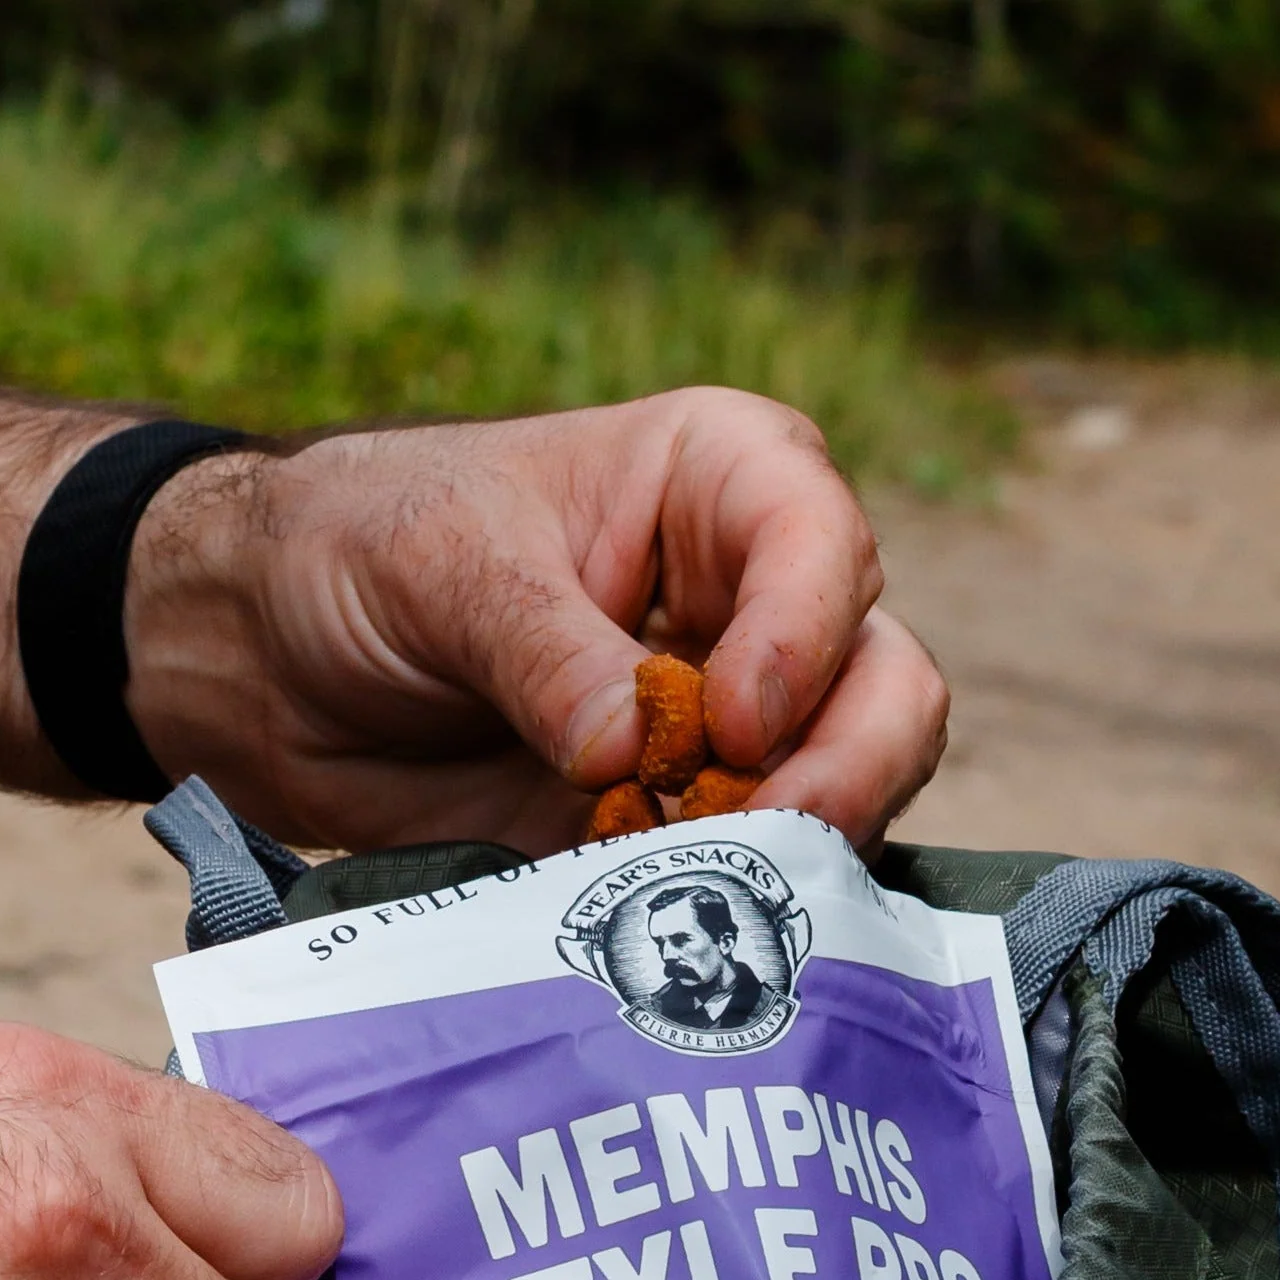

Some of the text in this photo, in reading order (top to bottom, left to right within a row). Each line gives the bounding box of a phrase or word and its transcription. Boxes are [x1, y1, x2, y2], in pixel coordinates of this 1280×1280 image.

[577, 847, 776, 919] PEAR'S SNACKS
[308, 924, 358, 961] SO
[372, 883, 478, 925] FULL
[716, 1010, 783, 1048] HERMANN
[460, 1085, 927, 1260] MEMPHIS
